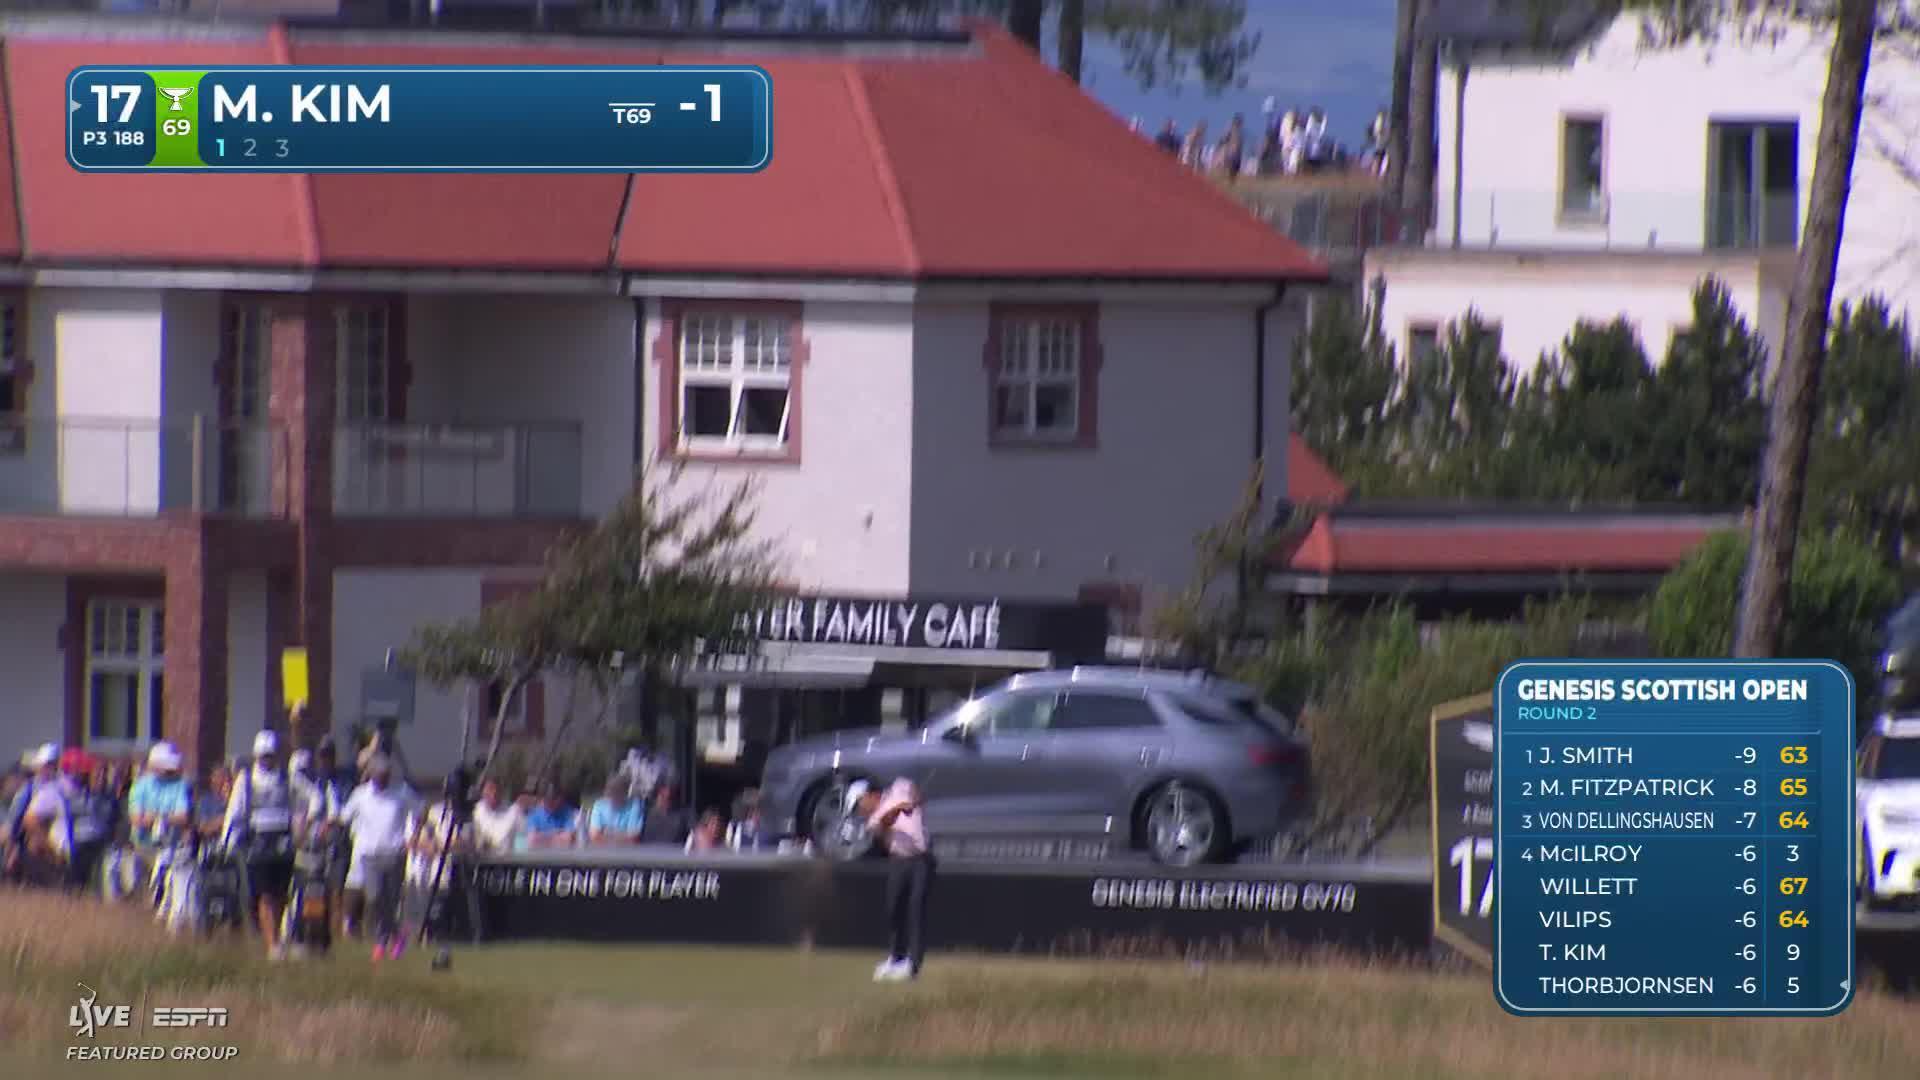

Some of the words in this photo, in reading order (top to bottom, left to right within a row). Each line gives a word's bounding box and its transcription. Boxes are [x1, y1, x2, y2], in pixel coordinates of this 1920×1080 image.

[813, 598, 919, 646] FAMILY
[529, 868, 551, 897] IN
[556, 868, 599, 898] ONE
[604, 869, 645, 898] FOR
[648, 870, 720, 900] PLAYER
[1092, 878, 1175, 909] GENESIS
[1180, 880, 1298, 911] ELECTRIFIED
